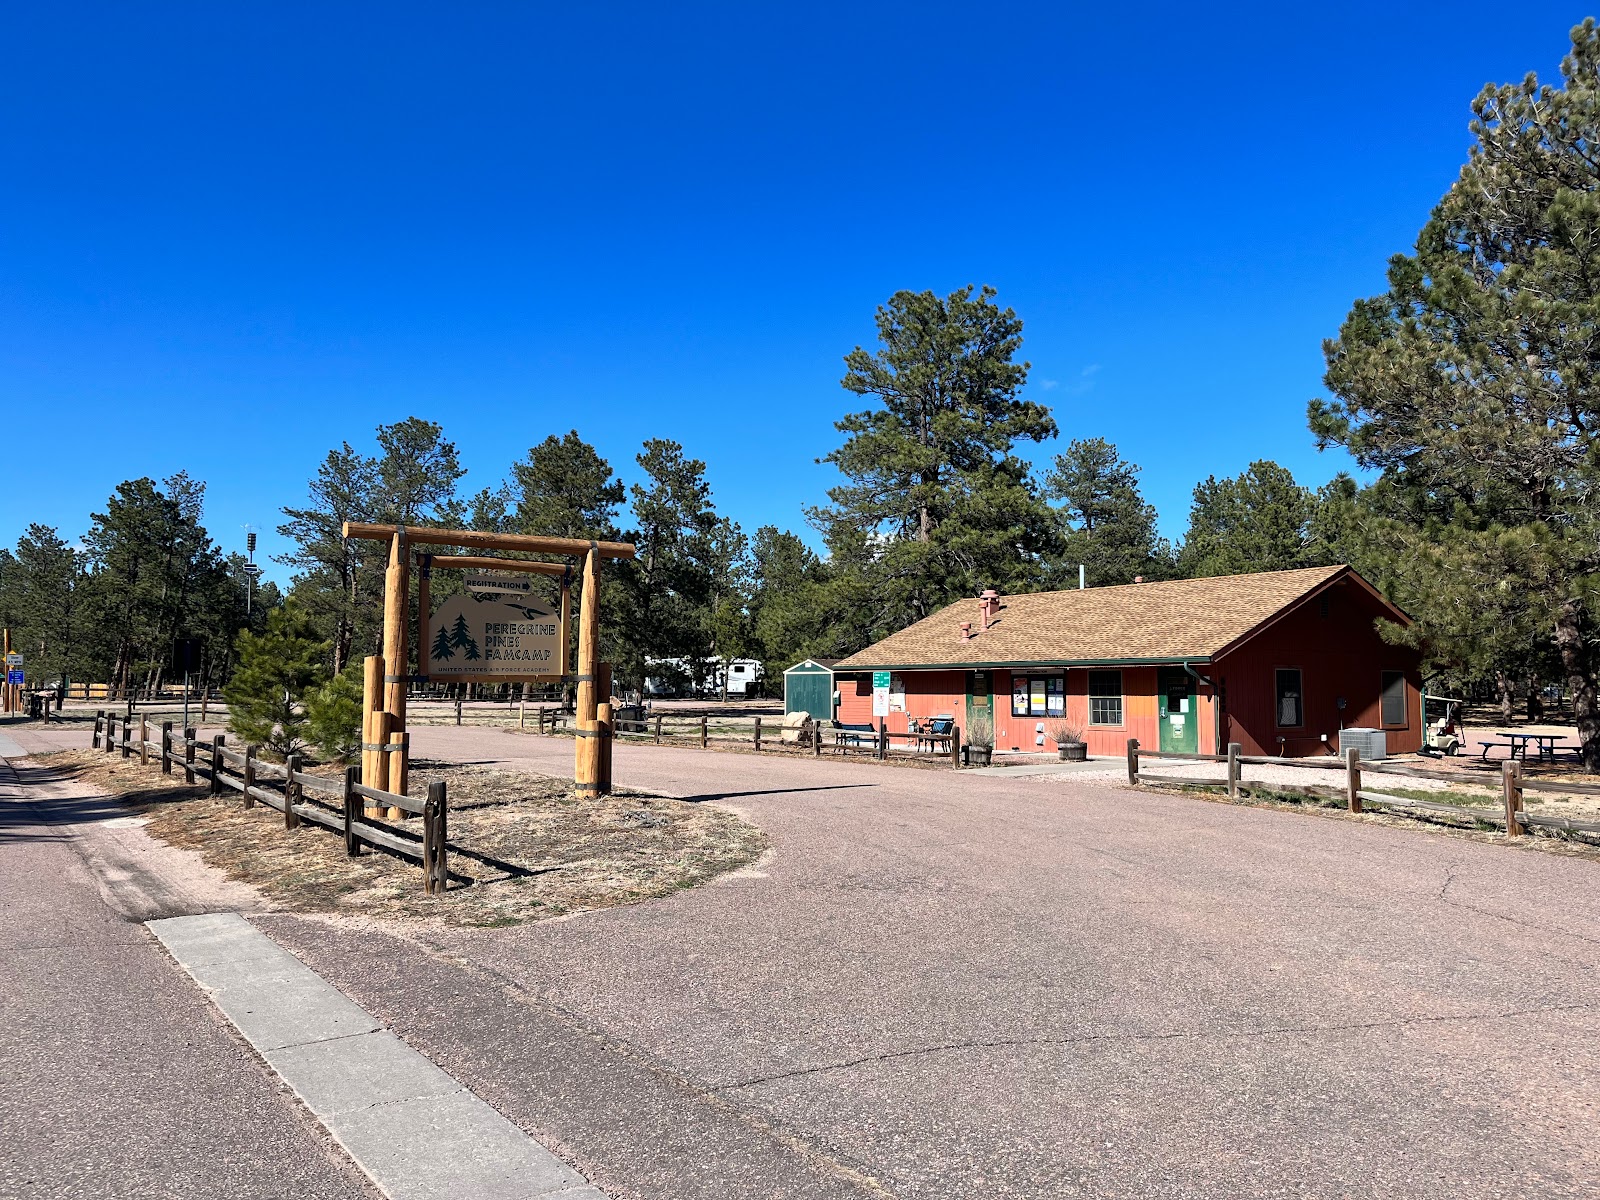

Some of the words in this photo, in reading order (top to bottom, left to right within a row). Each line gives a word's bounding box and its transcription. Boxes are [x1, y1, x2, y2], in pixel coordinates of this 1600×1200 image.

[466, 580, 521, 589] REGISTRATION
[485, 622, 556, 635] PEREGRINE
[485, 636, 521, 648] PINES
[485, 649, 552, 661] FAMCAMP
